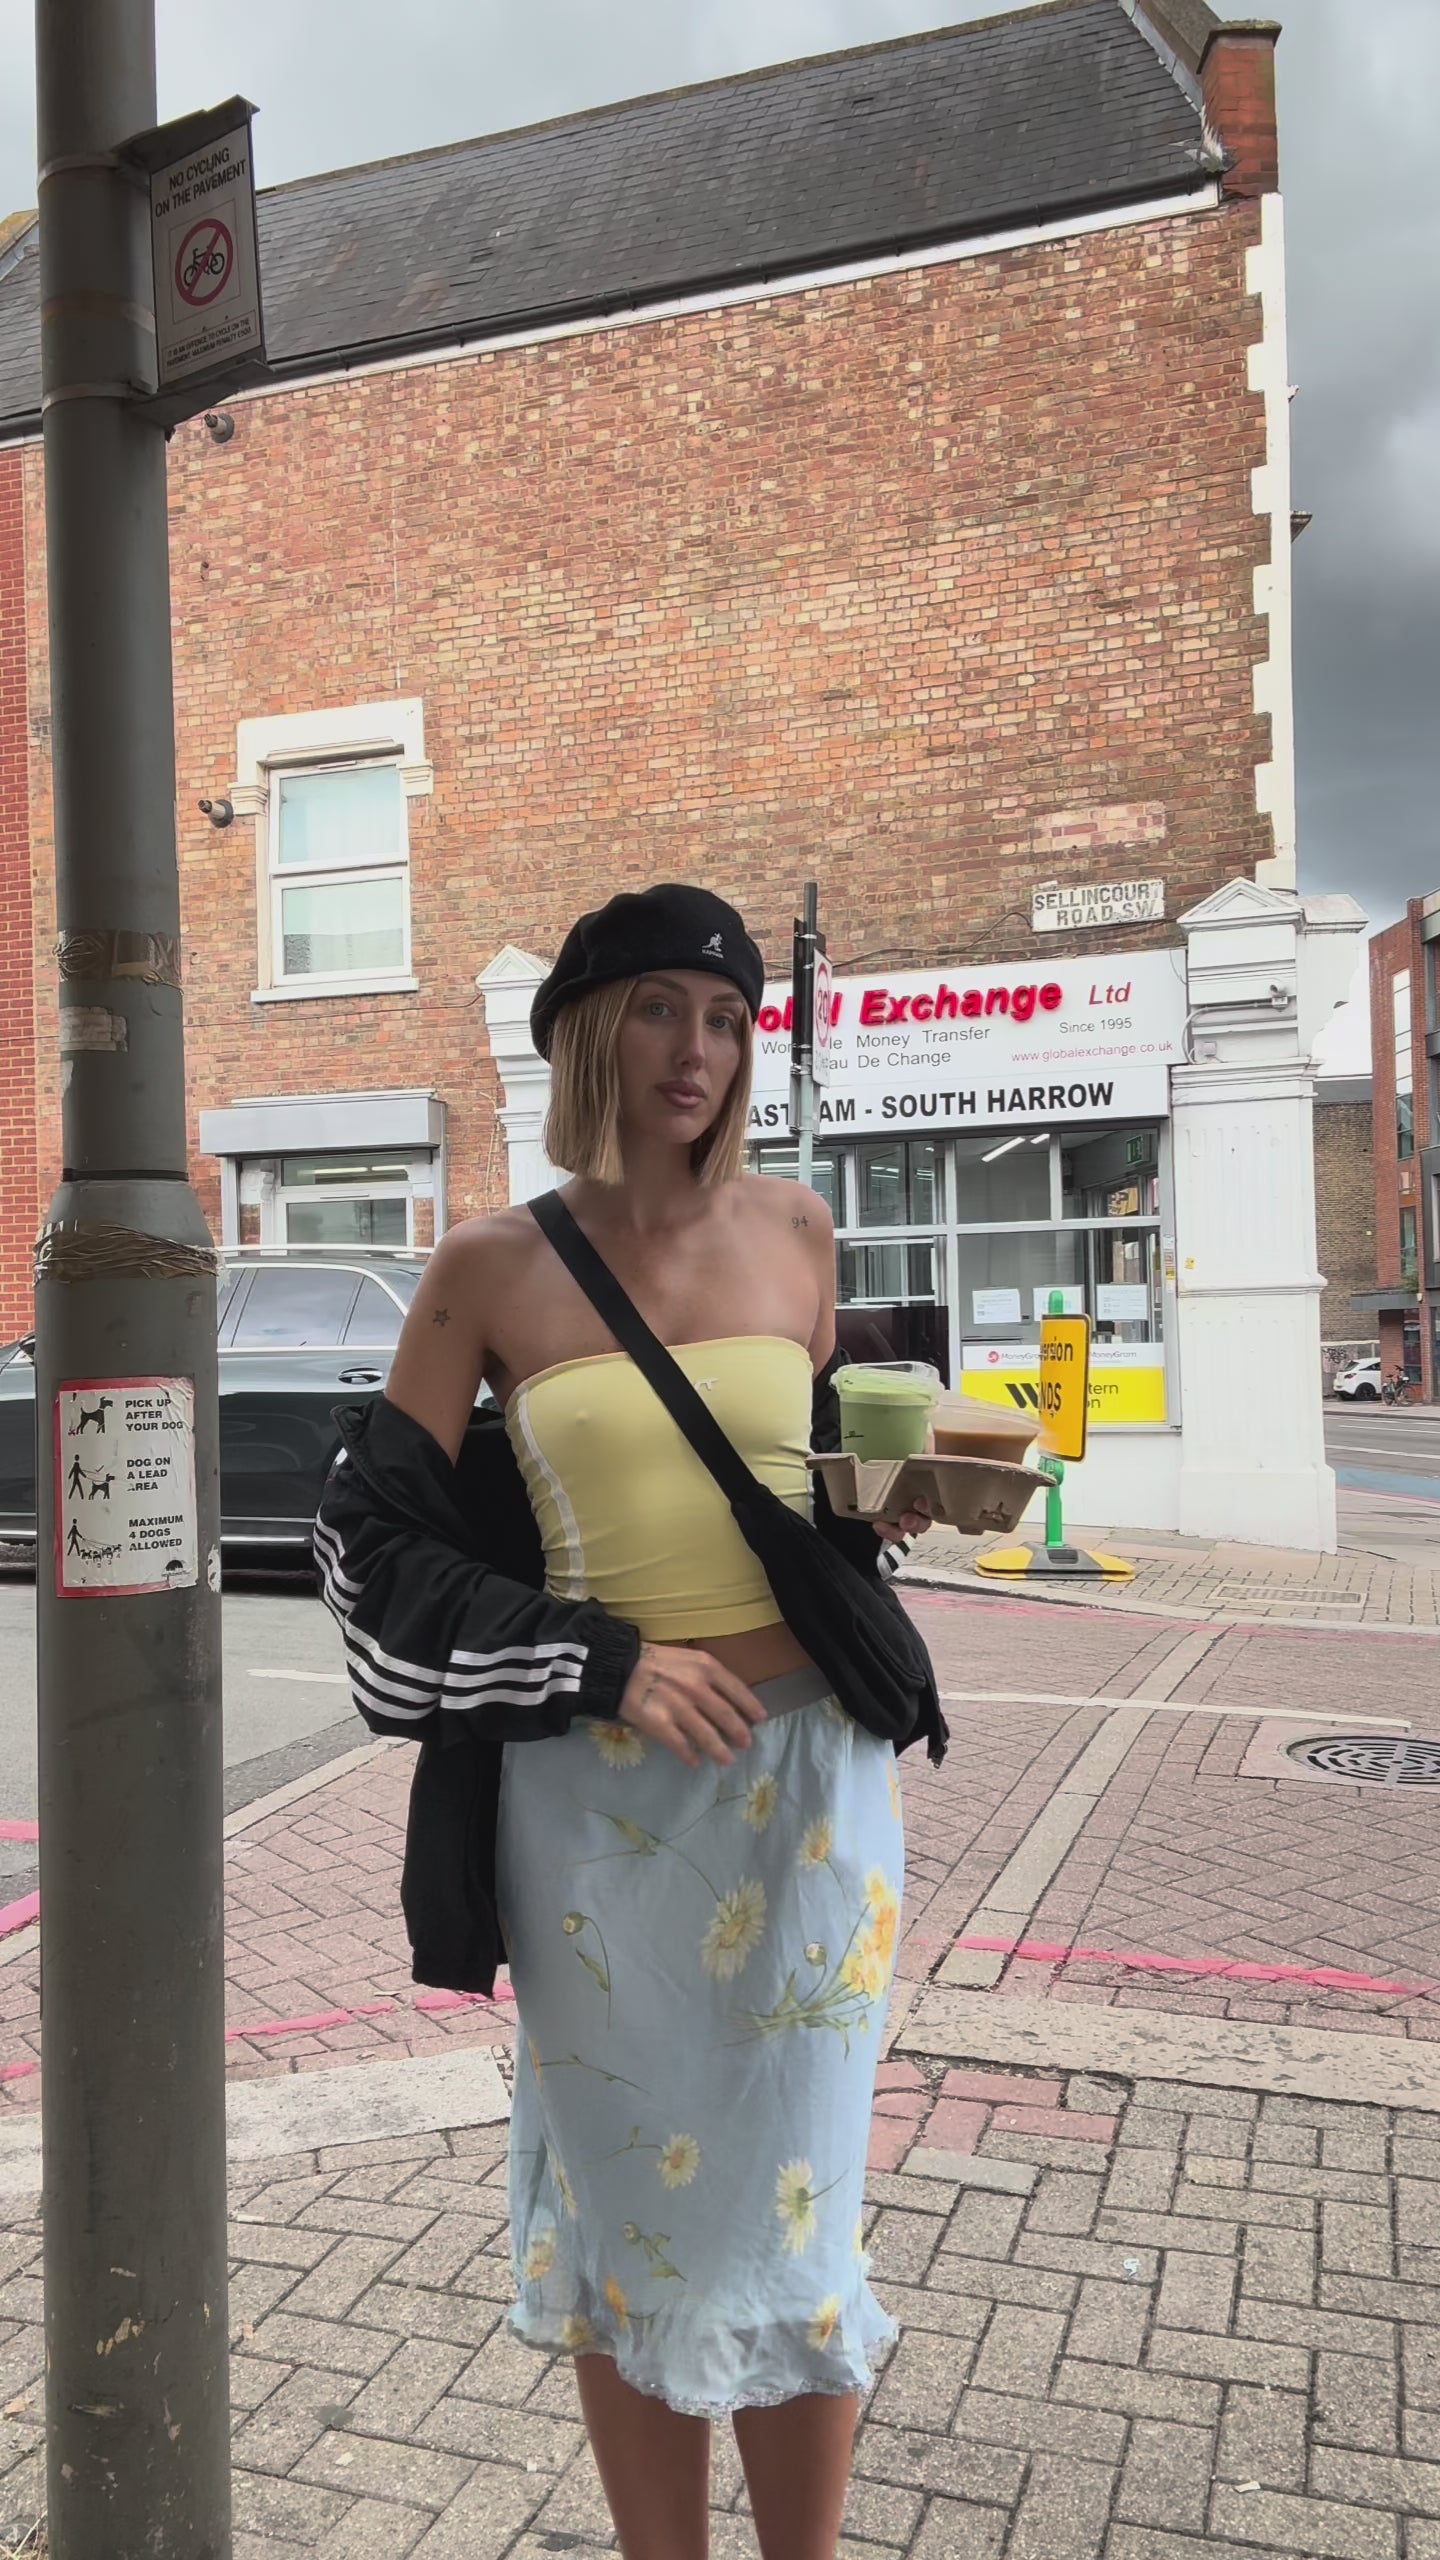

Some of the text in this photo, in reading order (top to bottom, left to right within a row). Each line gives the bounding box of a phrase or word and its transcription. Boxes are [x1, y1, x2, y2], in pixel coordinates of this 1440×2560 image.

[169, 147, 230, 191] NO CYCLING
[155, 160, 246, 218] ON THE PAVEMENT
[1034, 882, 1163, 910] SELLINCOURT
[1057, 905, 1113, 926] ROAD
[859, 983, 1063, 1027] Exchange
[1088, 982, 1131, 1006] Ltd
[1059, 1017, 1133, 1034] Since 1995
[856, 1034, 910, 1049] Money
[922, 1026, 991, 1043] Transfer
[858, 1055, 880, 1068] De
[887, 1051, 951, 1068] Change
[1011, 1040, 1174, 1063] www.globalexchange.co.uk
[748, 1103, 789, 1127] AST
[819, 1098, 855, 1122] AM
[881, 1090, 977, 1120] SOUTH
[987, 1081, 1114, 1114] HARROW
[125, 1399, 171, 1408] PICK UP
[126, 1411, 163, 1420] AFTER
[125, 1420, 184, 1431] YOUR DOG
[127, 1457, 171, 1467] DOG ON
[127, 1469, 168, 1479] A LEAD
[129, 1515, 184, 1527] MAXIMUM
[129, 1528, 171, 1539] 4 DOGS
[129, 1538, 183, 1551] ALLOWED
